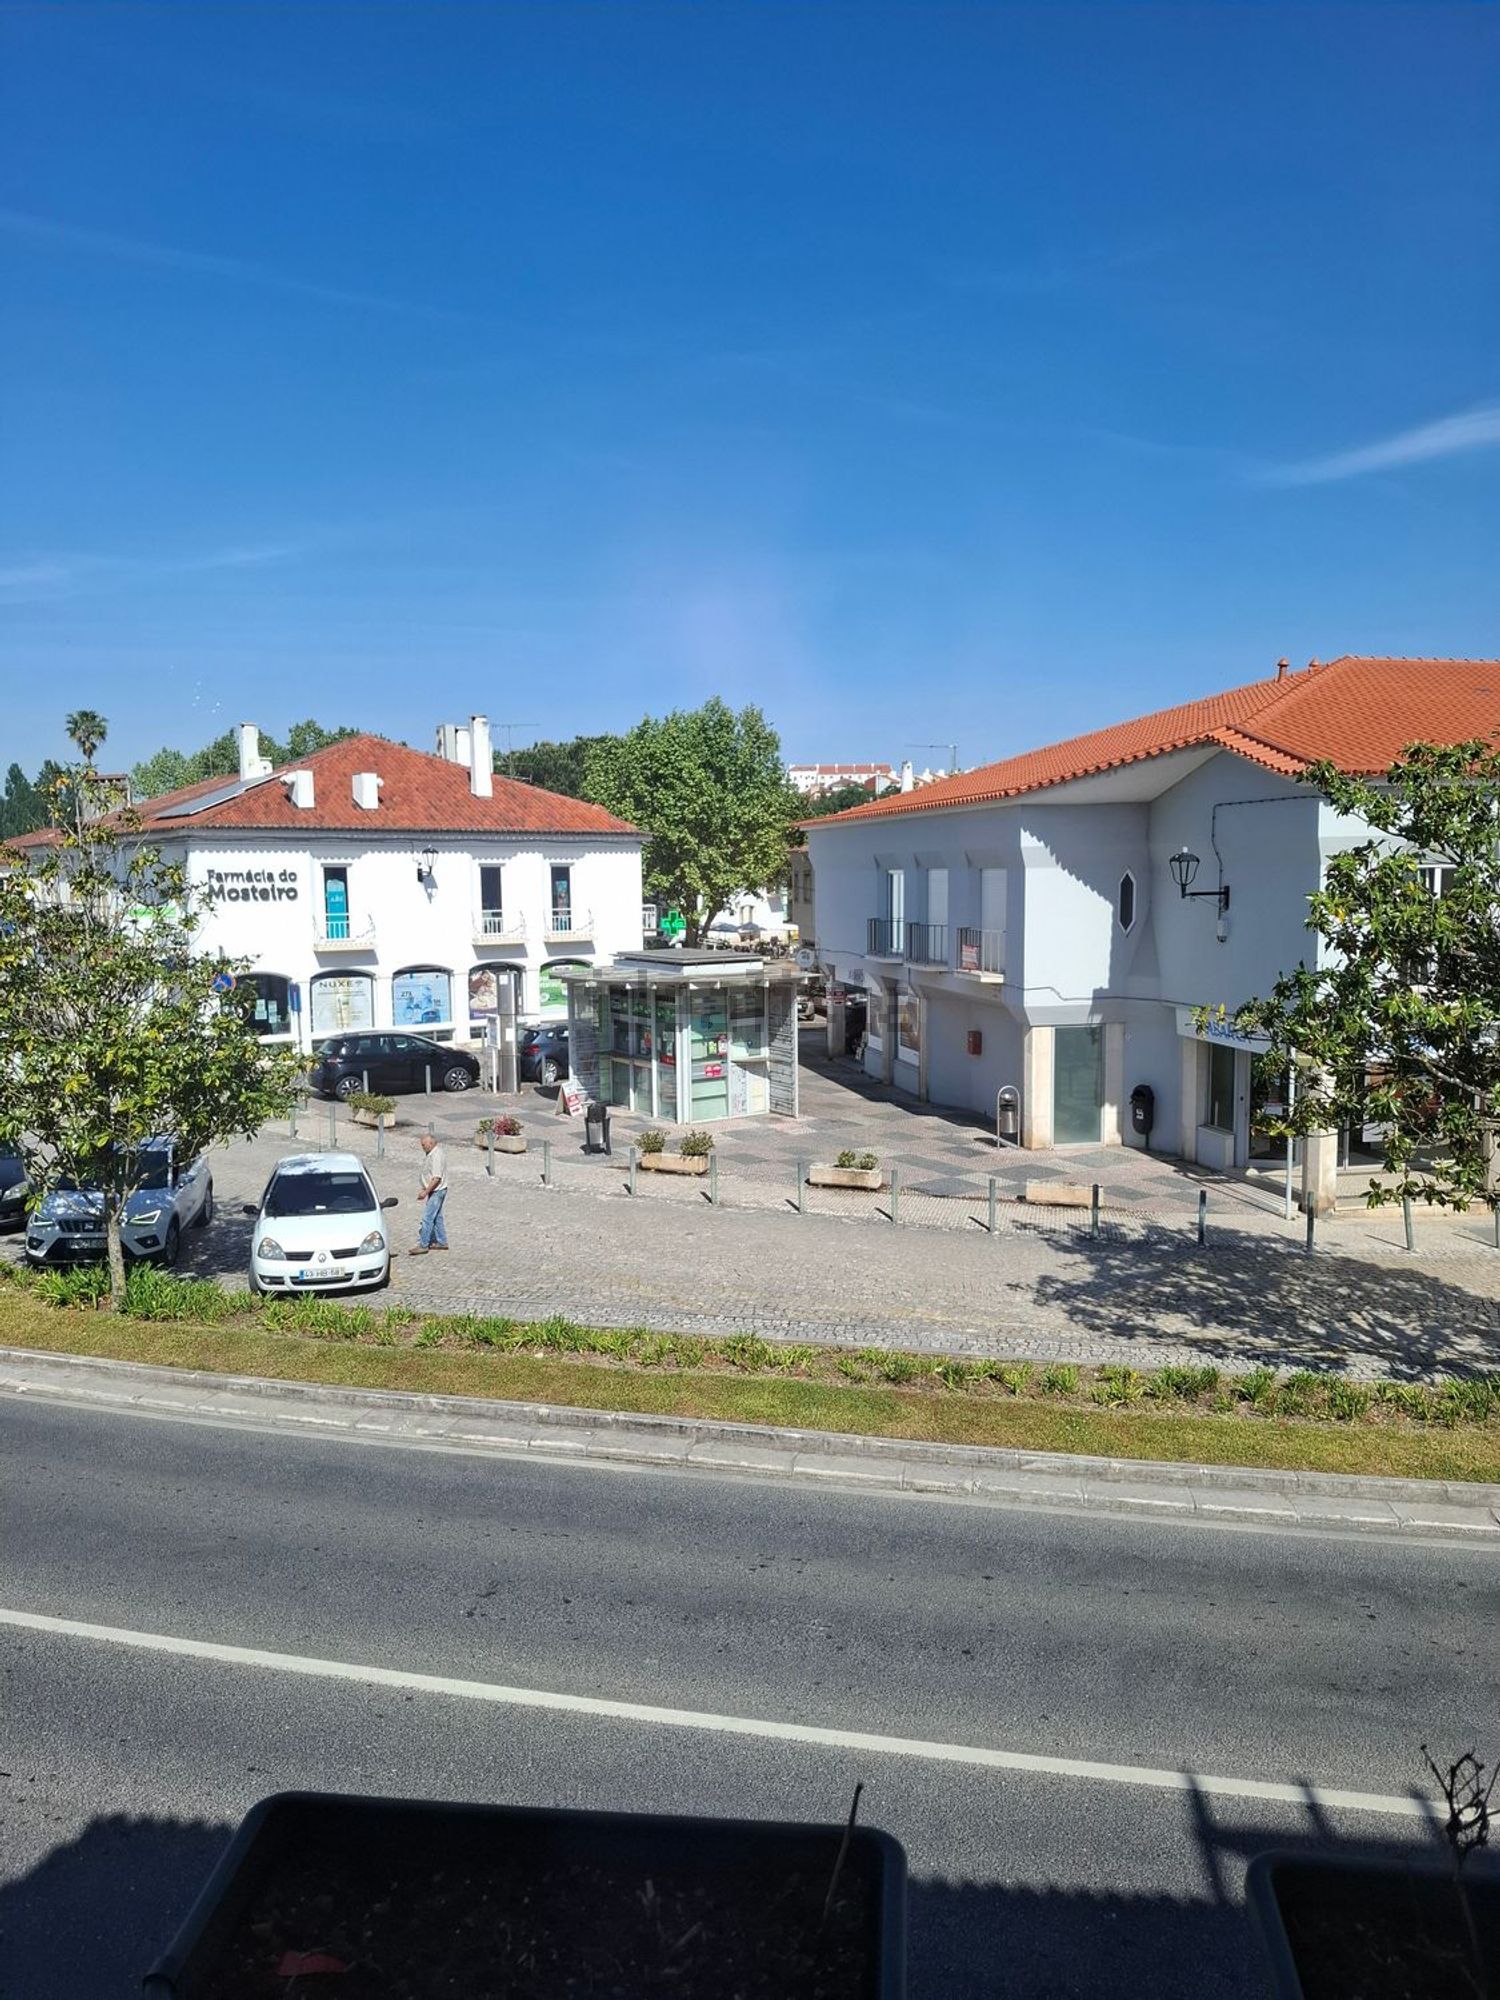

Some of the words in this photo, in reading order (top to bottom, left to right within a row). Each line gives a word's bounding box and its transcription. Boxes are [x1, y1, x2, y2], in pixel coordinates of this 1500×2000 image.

[207, 868, 275, 883] Farmácia
[278, 868, 298, 882] do
[208, 883, 298, 902] Mosteiro
